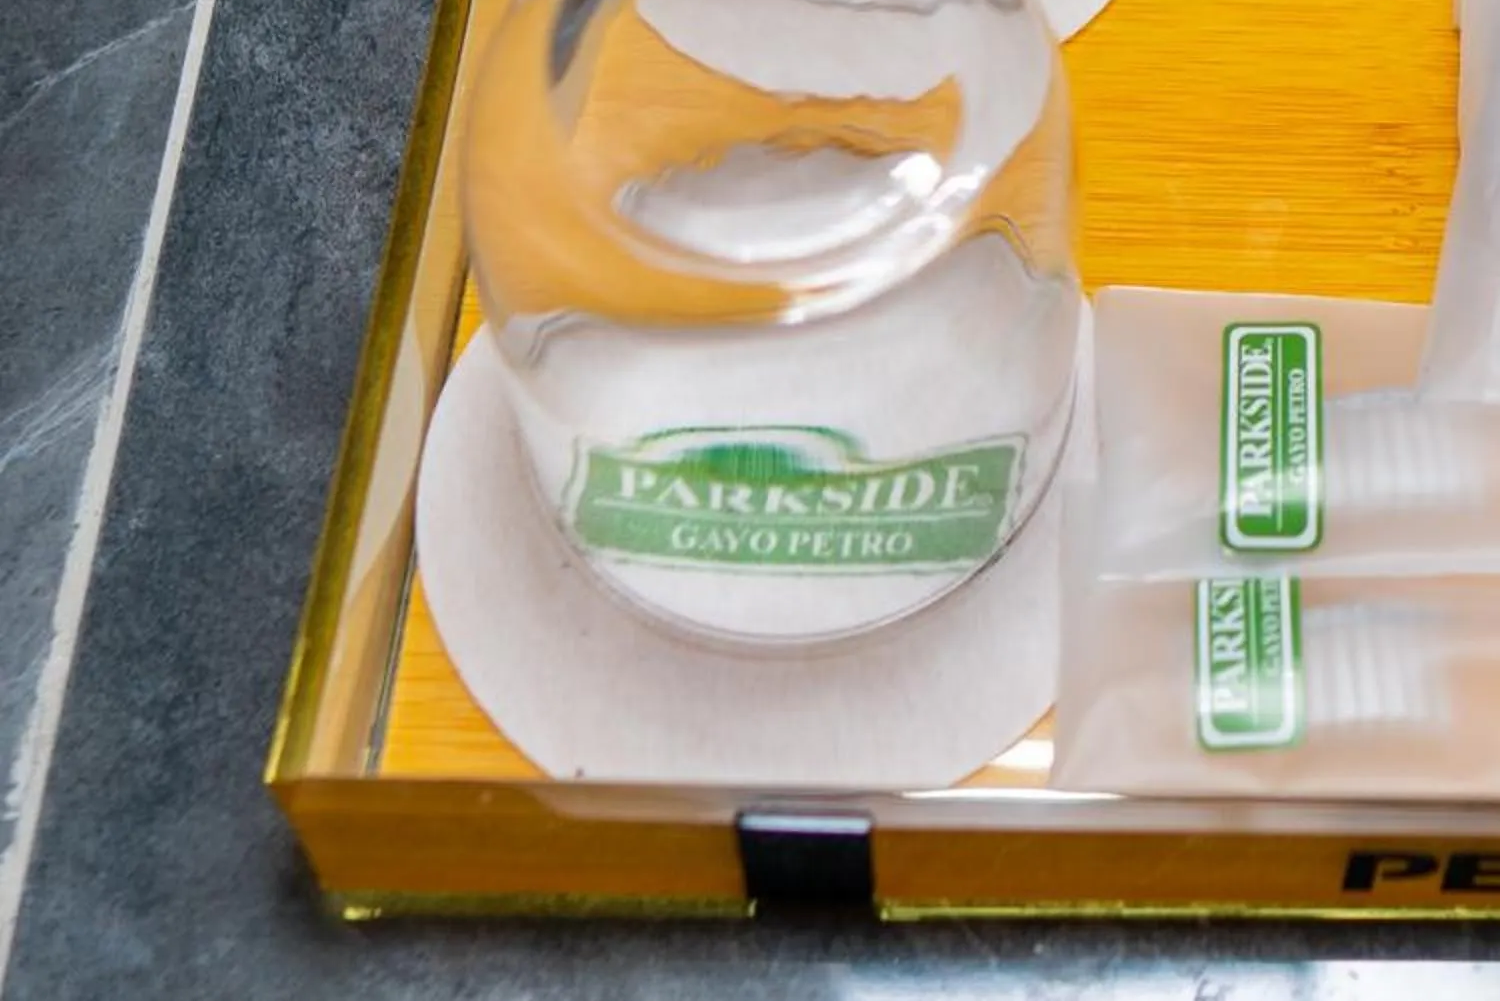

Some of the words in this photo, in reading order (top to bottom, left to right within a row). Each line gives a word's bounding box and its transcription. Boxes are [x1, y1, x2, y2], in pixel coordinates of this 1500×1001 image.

[1240, 344, 1274, 517] PARKSIDE
[1287, 426, 1306, 483] GAYO
[618, 463, 982, 516] PARKSIDE
[671, 523, 778, 553] GAYO
[788, 529, 913, 558] PETRO
